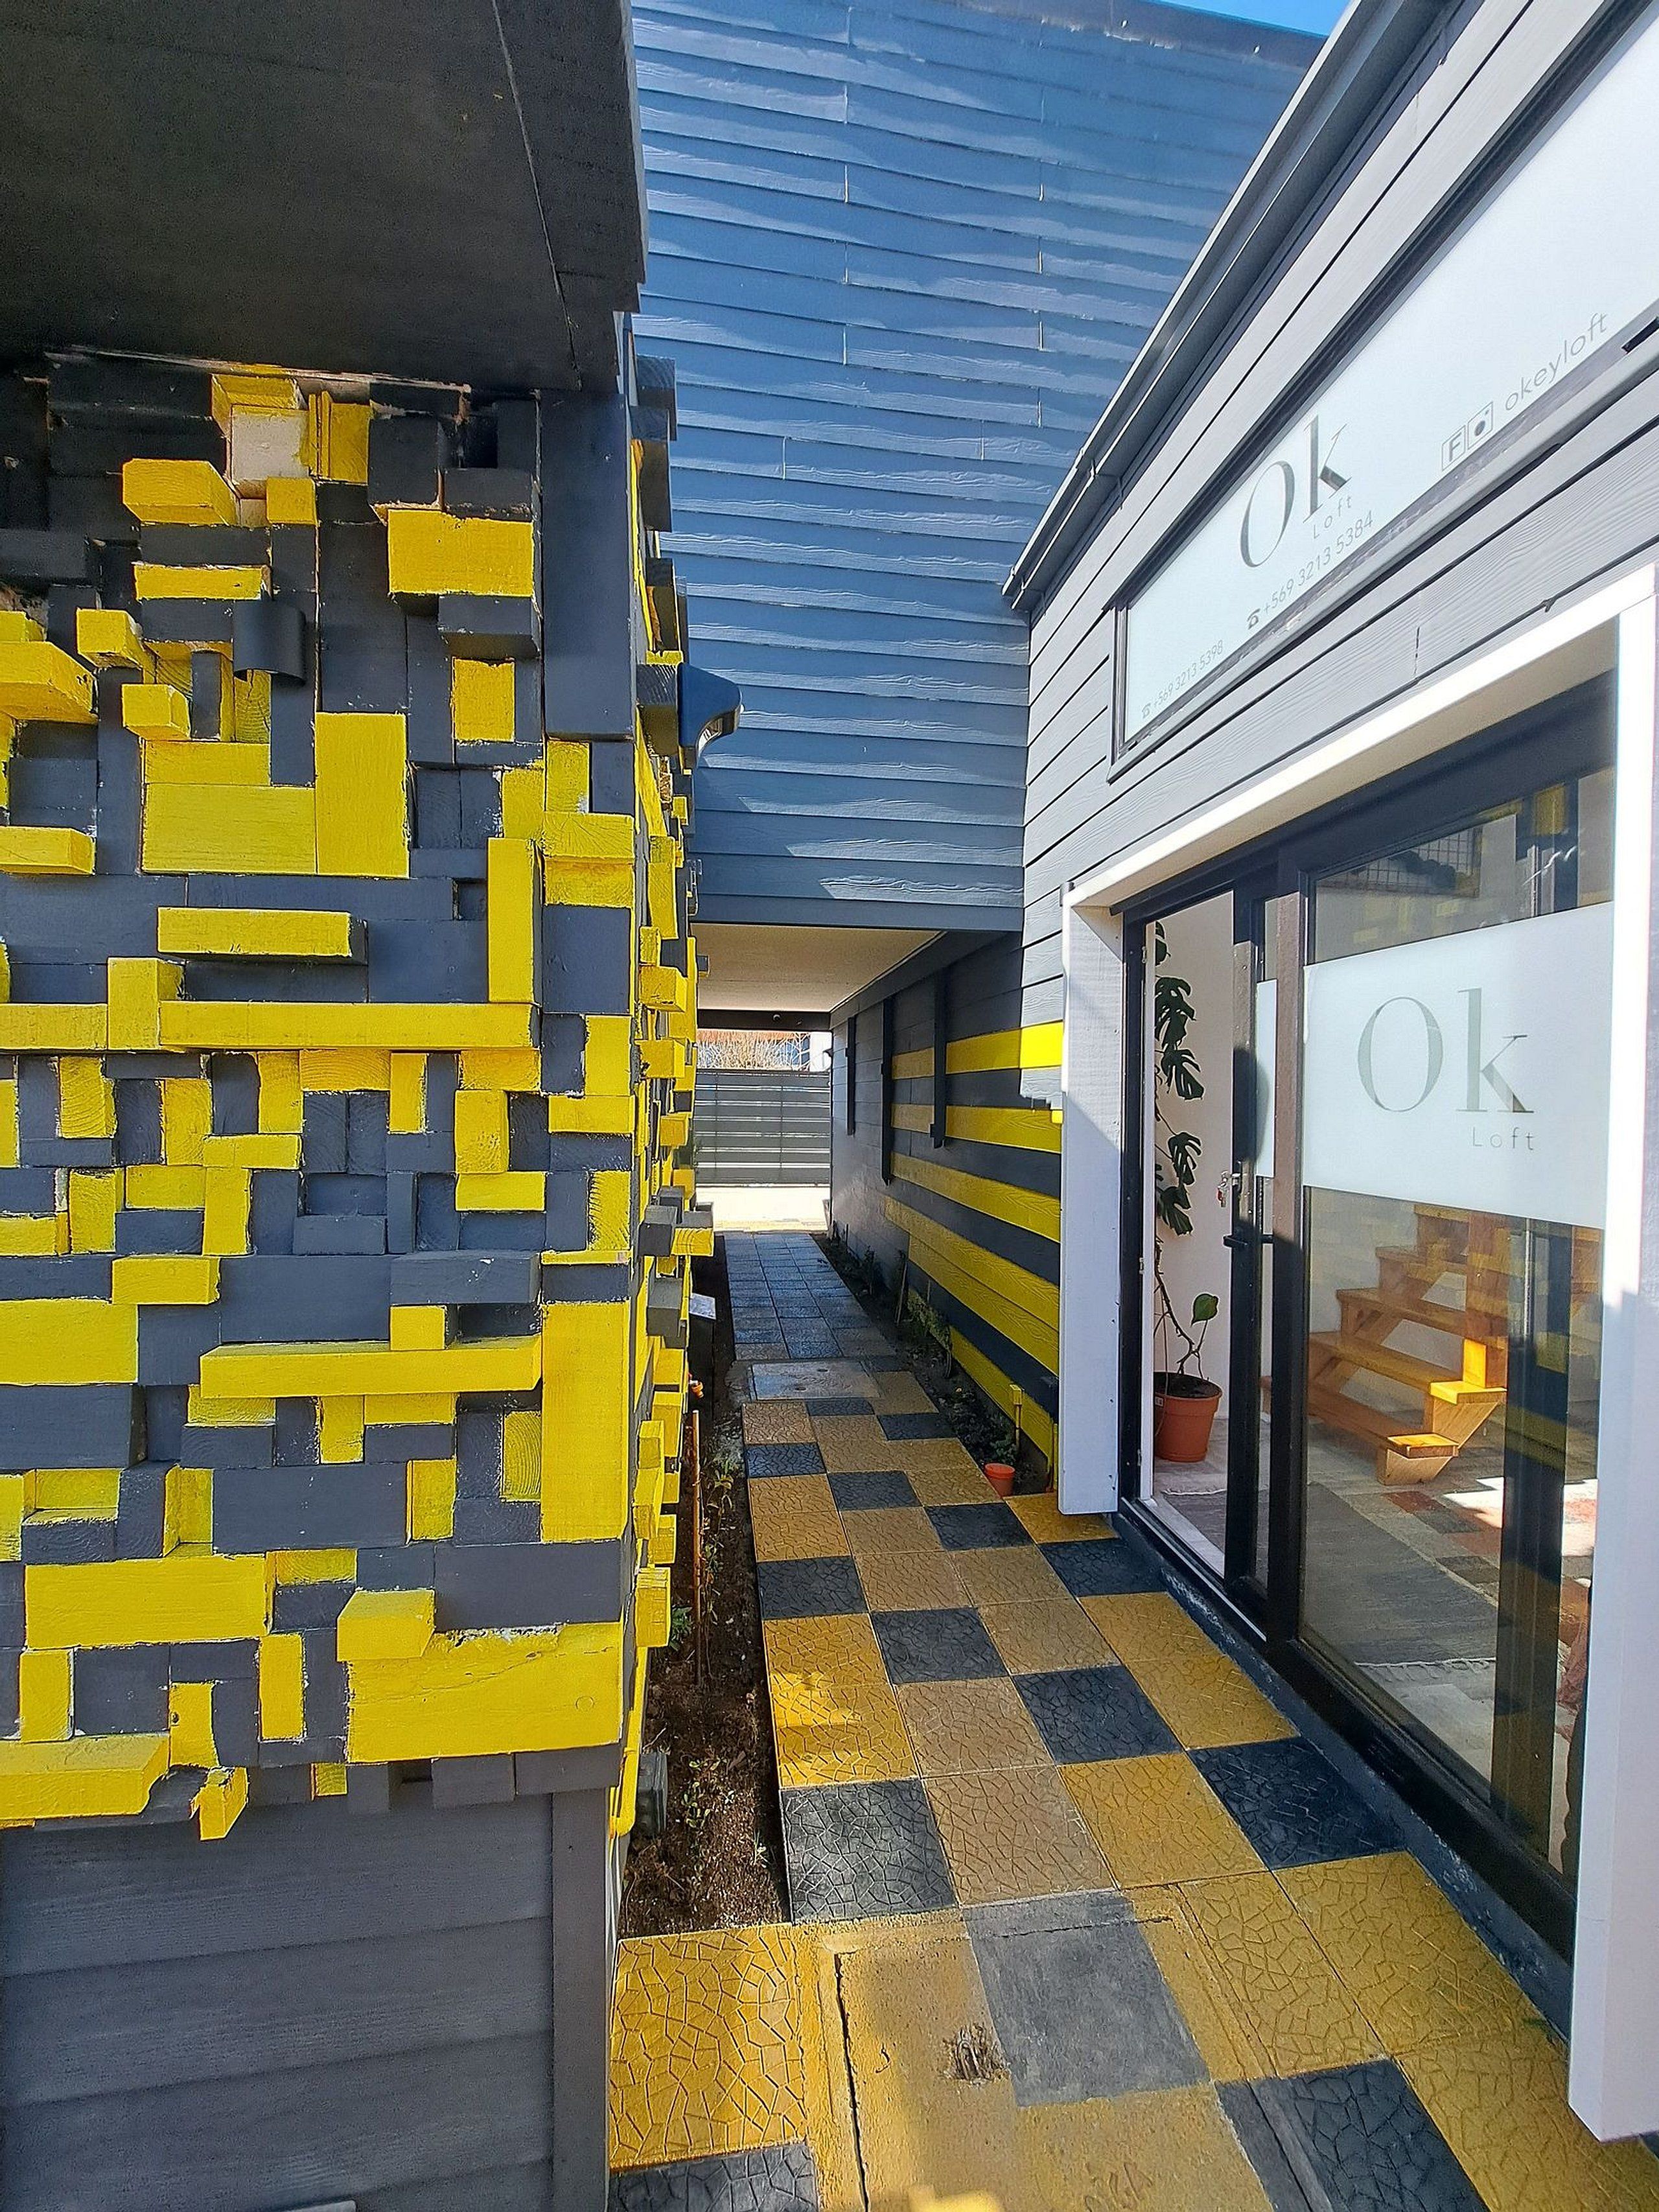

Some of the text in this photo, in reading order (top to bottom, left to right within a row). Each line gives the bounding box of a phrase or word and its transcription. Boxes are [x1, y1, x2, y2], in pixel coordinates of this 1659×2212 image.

[1505, 312, 1608, 412] okeyloft
[1240, 415, 1352, 569] Ok
[1313, 496, 1352, 539] Loft
[1264, 510, 1373, 614] +569 3213 5384
[1174, 662, 1197, 691] 3213
[1199, 639, 1224, 670] 5398
[1357, 987, 1535, 1113] Ok
[1472, 1126, 1535, 1151] Loft
